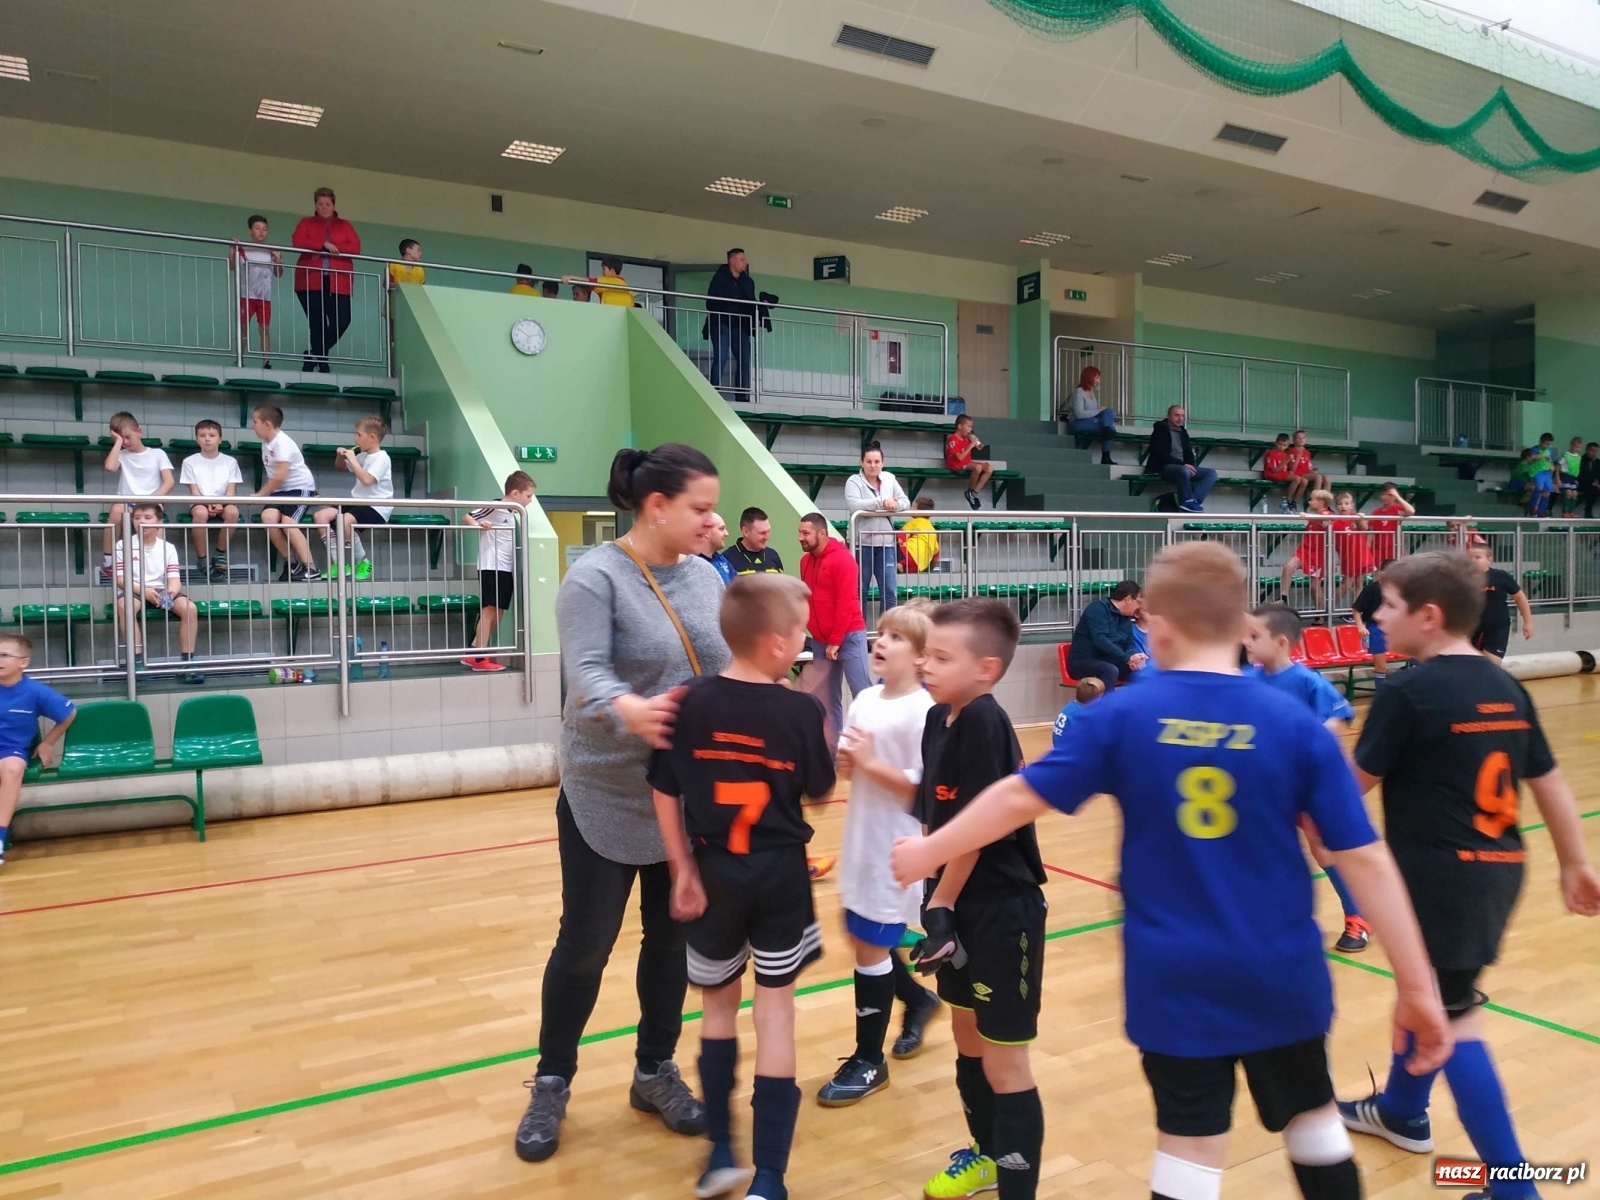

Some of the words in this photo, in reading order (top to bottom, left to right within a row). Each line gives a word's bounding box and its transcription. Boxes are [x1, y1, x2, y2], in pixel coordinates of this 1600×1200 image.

[822, 264, 837, 278] F
[1023, 282, 1035, 300] F
[714, 780, 771, 855] 7
[1175, 765, 1239, 840] 8
[1472, 751, 1519, 839] 9
